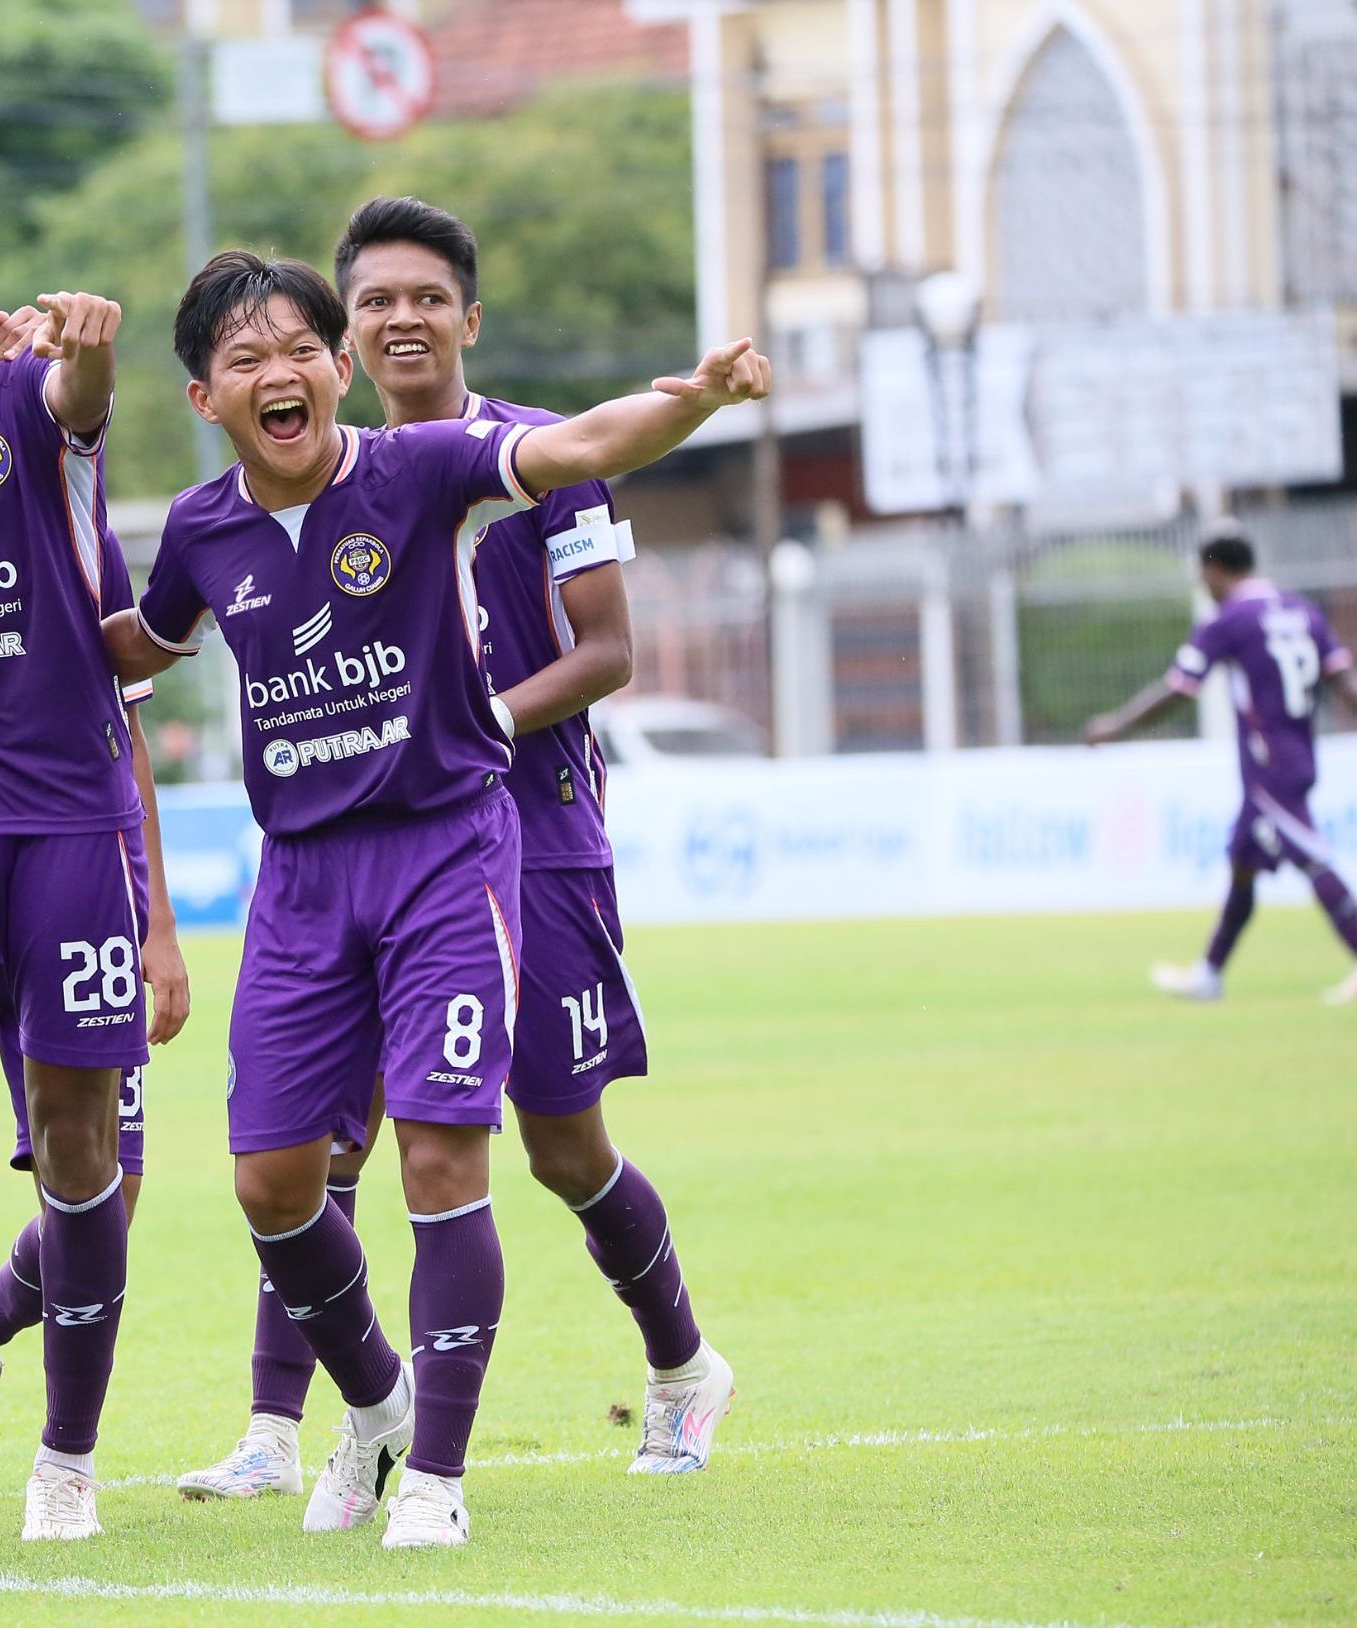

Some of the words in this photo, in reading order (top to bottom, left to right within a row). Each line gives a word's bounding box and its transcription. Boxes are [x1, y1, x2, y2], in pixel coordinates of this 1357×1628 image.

[550, 537, 594, 562] RACISM
[226, 594, 272, 617] ZESTIEN
[245, 658, 333, 709] bank
[333, 640, 406, 688] bjb
[253, 707, 324, 732] Tandamata
[325, 694, 367, 716] Untuk
[368, 681, 412, 704] Negeri
[272, 750, 294, 767] AR
[60, 936, 137, 1013] 28
[76, 1012, 136, 1029] ZESTIEN
[443, 994, 484, 1069] 8
[561, 982, 608, 1060] 14
[426, 1071, 484, 1088] ZESTIEN
